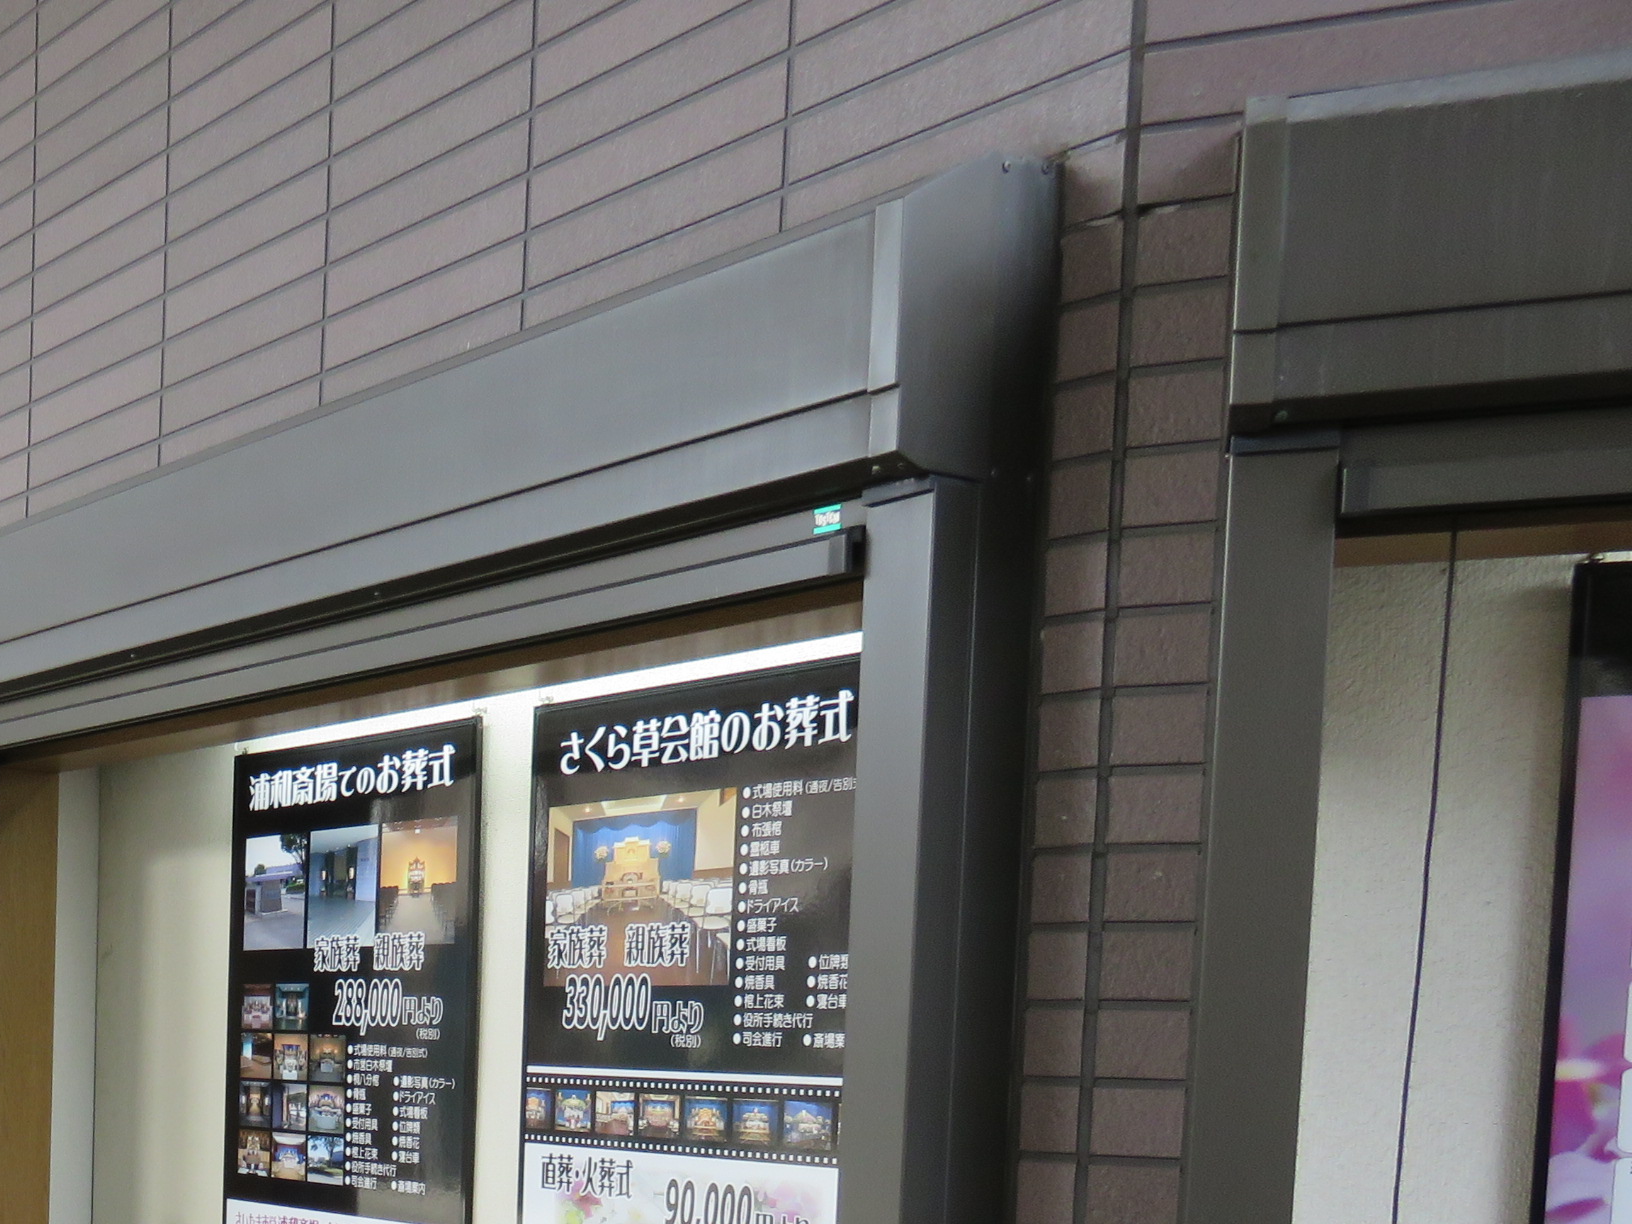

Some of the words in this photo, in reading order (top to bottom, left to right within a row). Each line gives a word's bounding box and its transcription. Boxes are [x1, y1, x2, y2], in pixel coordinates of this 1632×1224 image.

[558, 689, 855, 775] さくら草会館のお葬式
[747, 898, 800, 914] ドライアイス
[746, 917, 777, 933] 盛菓子
[313, 934, 361, 972] 家族葬
[373, 931, 426, 971] 親族葬
[547, 924, 608, 969] 家族葬
[624, 921, 691, 968] 親族葬
[746, 935, 787, 952] 式場看板
[745, 955, 785, 971] 受付用具
[744, 974, 775, 990] 焼香具
[561, 973, 705, 1041] 330,000円より
[742, 1013, 814, 1029] 役所手続き代行
[670, 1034, 702, 1048] (税別)
[742, 1031, 783, 1047] 司会進行
[399, 1090, 436, 1105] ドライアイス
[351, 1175, 378, 1190] 司会進行
